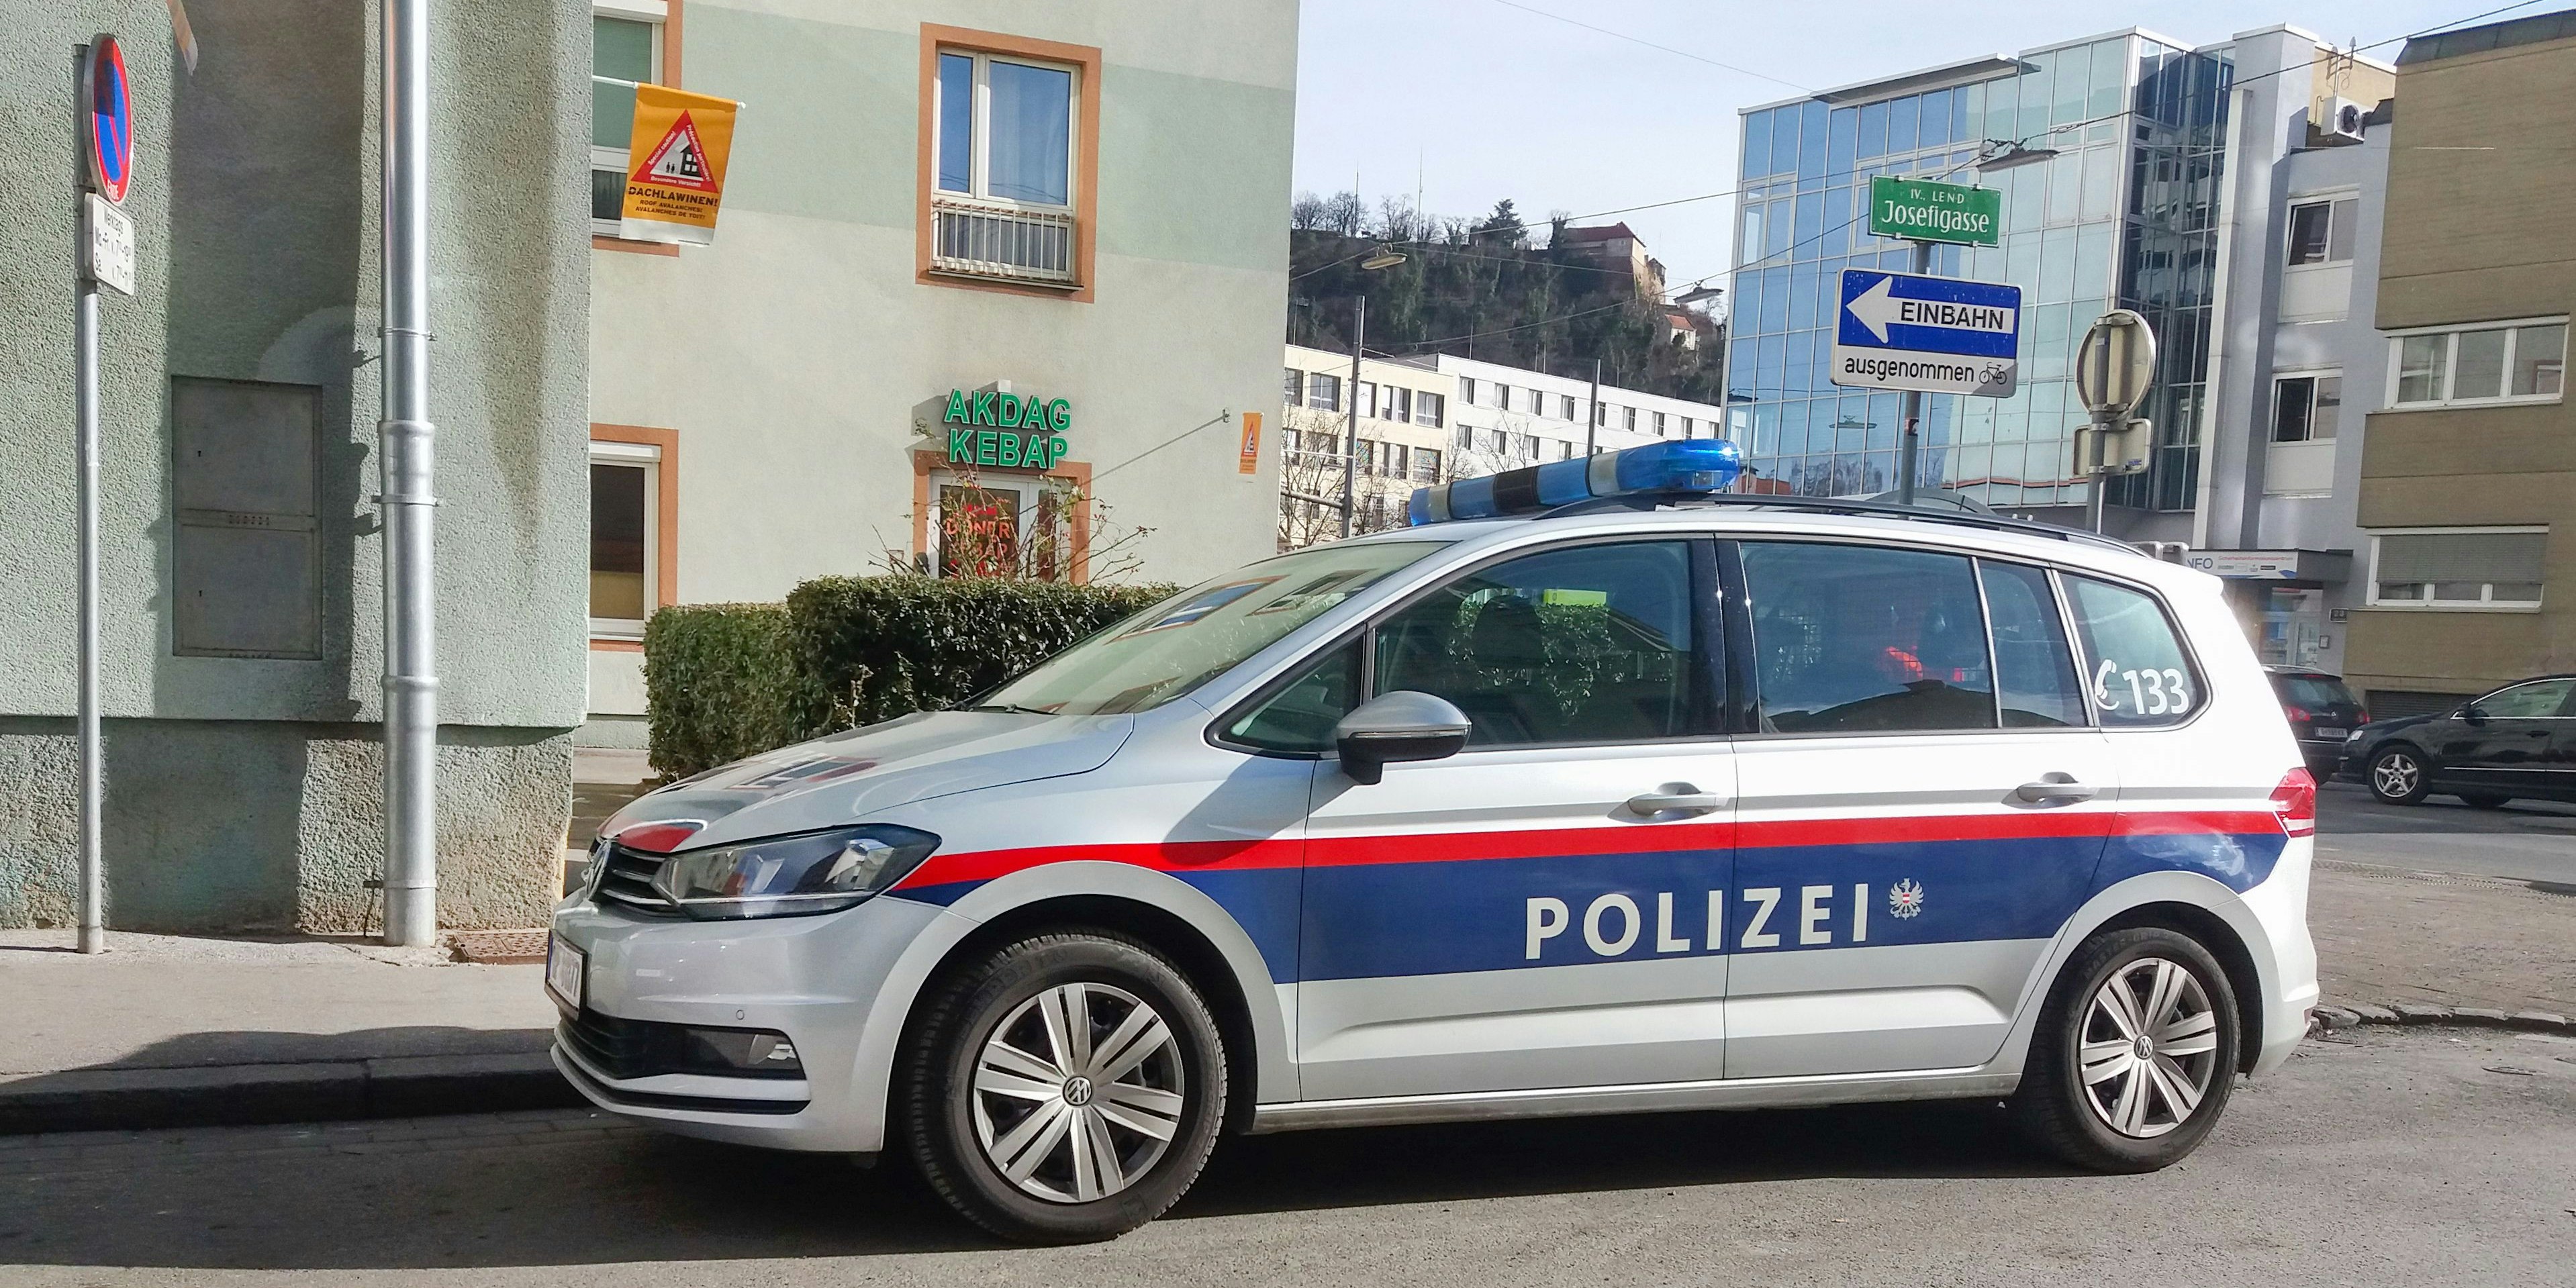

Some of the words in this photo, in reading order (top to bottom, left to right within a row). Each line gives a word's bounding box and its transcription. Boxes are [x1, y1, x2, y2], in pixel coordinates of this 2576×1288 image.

[628, 186, 718, 207] DACHLAWINEN!
[635, 206, 677, 215] AVALANCHES
[659, 202, 703, 213] AVALANCHES!
[1932, 191, 1964, 204] LEND
[1882, 200, 1989, 233] Josefigasse
[1901, 302, 2004, 330] EINBAHN
[1845, 357, 1974, 383] ausgenommen
[944, 389, 1071, 432] AKDAG
[949, 428, 1069, 470] KEBAP
[2122, 668, 2189, 715] 133
[1525, 883, 1869, 960] POLIZEI
